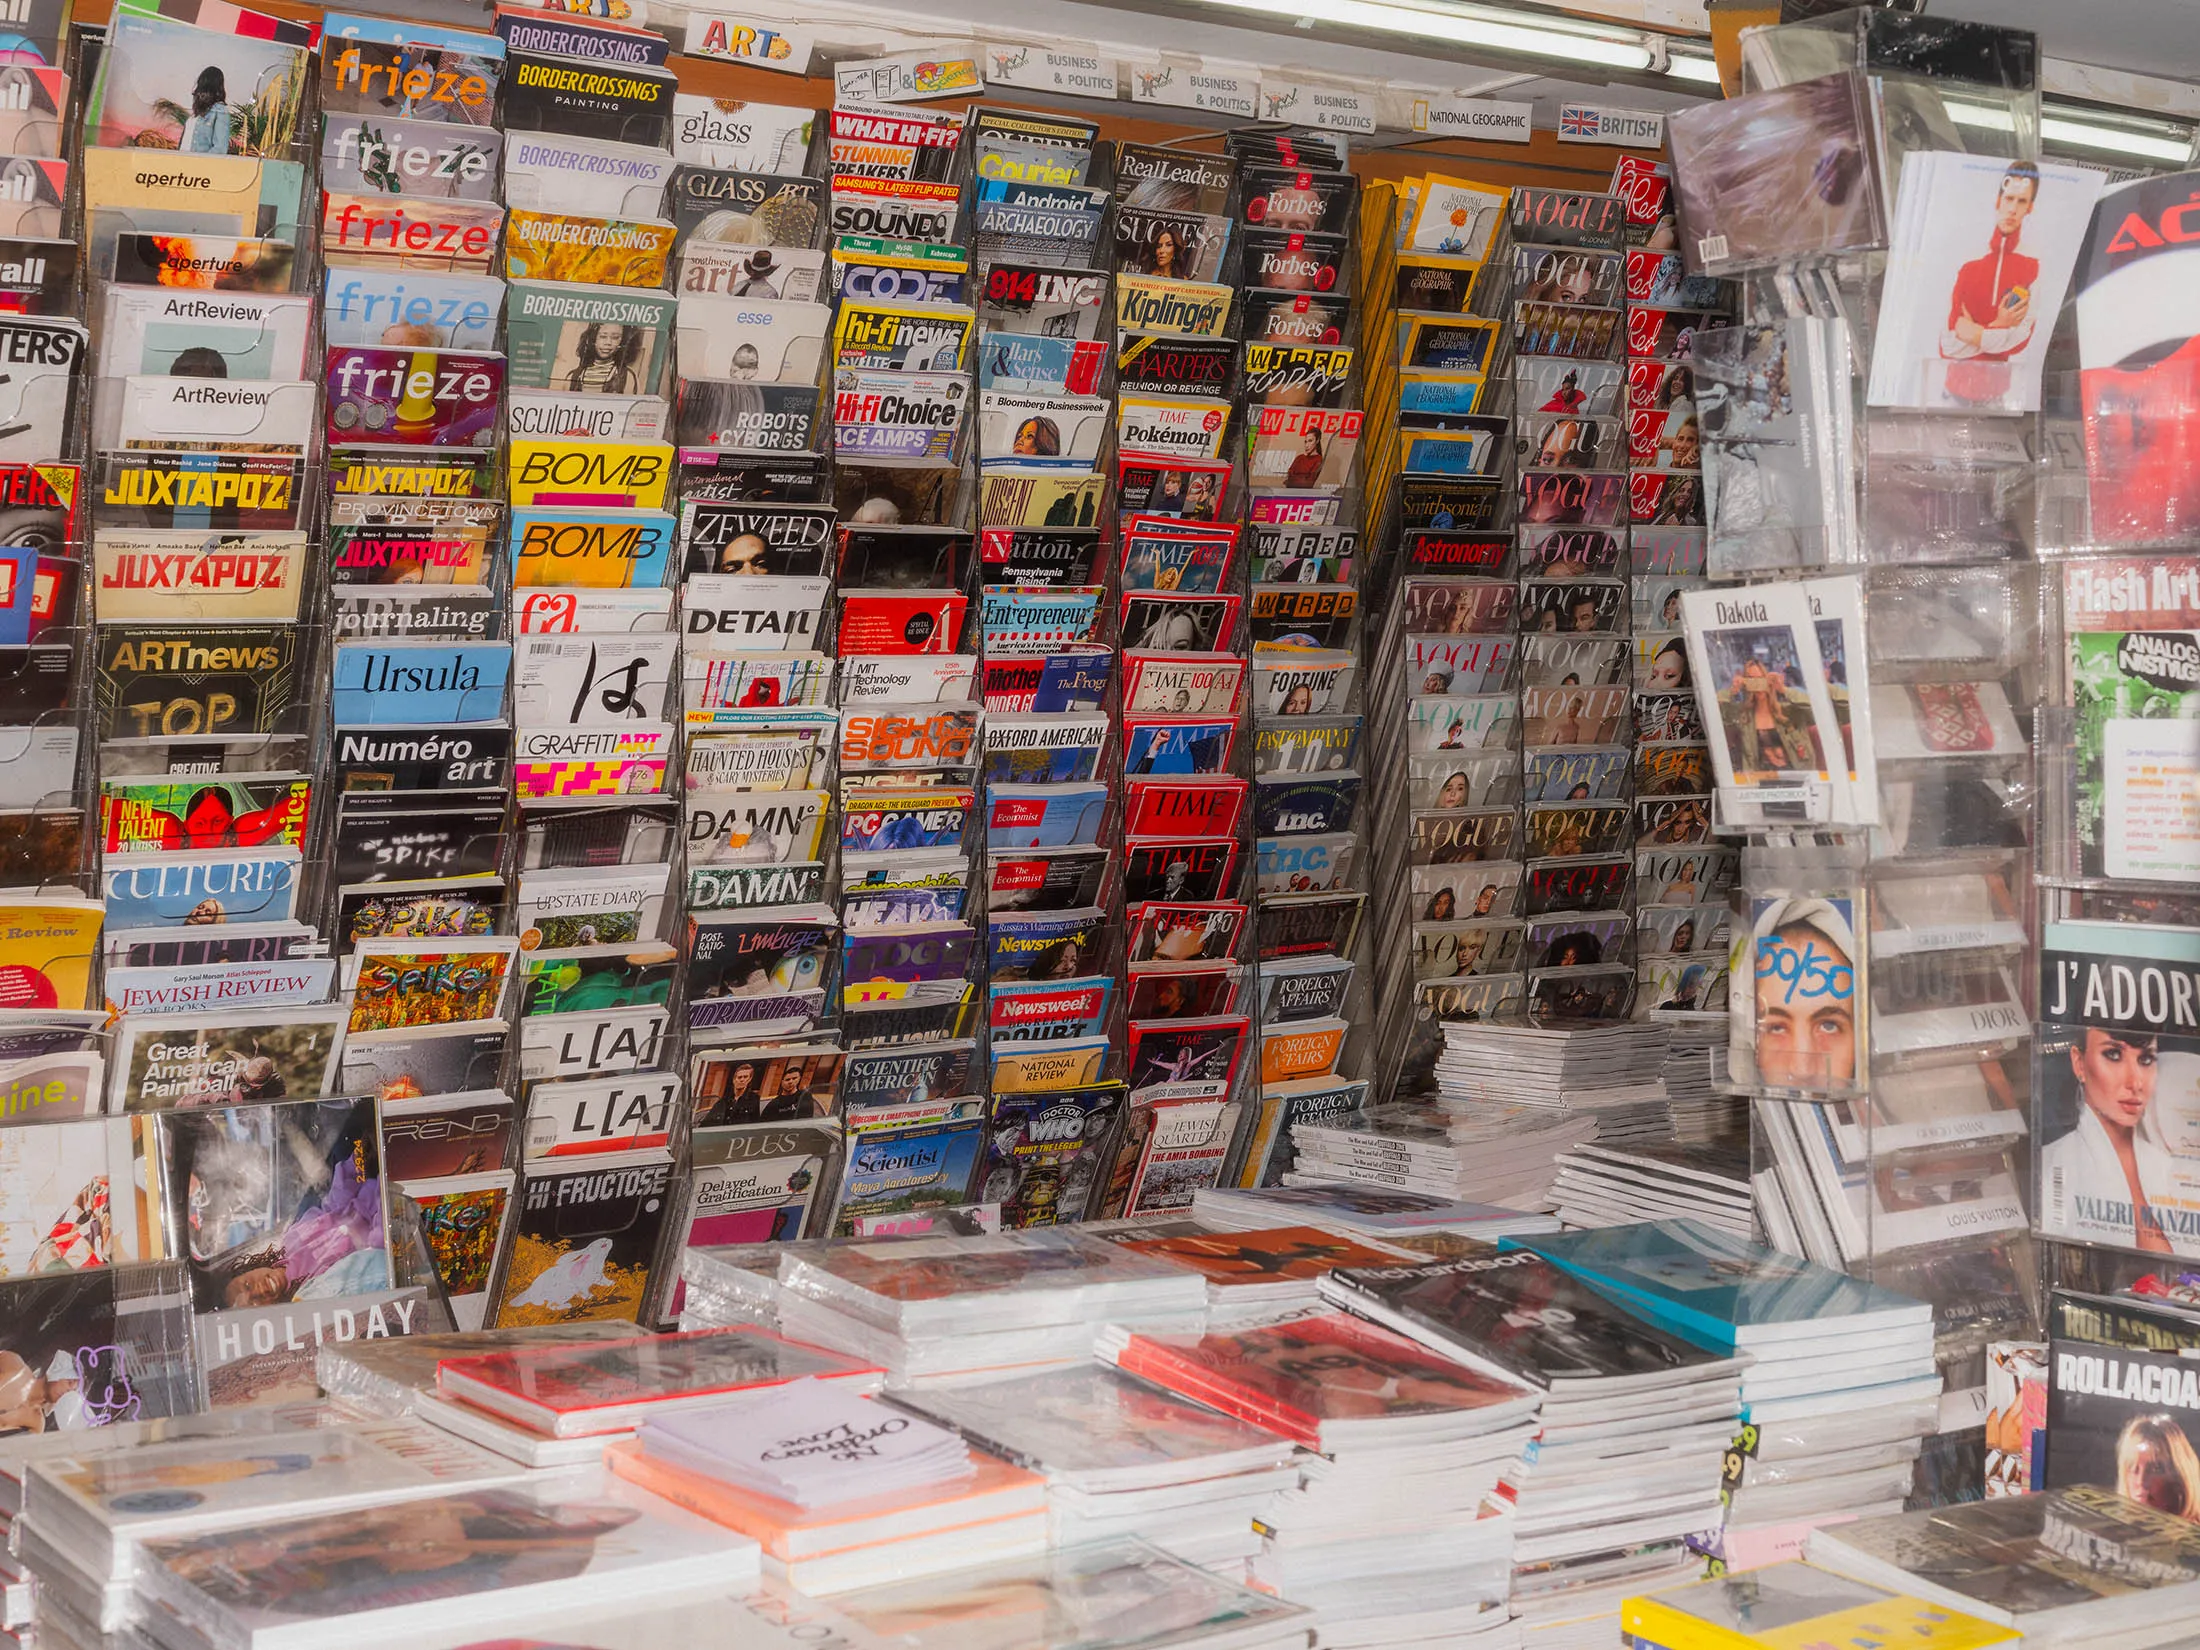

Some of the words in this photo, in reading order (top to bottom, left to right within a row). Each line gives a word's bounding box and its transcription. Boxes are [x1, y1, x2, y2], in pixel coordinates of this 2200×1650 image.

[509, 25, 652, 65] BORDERCROSSINGS
[1047, 54, 1098, 70] BUSINESS
[333, 50, 488, 106] frieze
[518, 64, 662, 102] BORDERCROSSINGS
[1054, 73, 1063, 84] &
[1068, 74, 1113, 90] POLITICS
[1190, 76, 1238, 91] BUSINESS
[555, 96, 619, 112] PAINTING
[1196, 94, 1204, 105] &
[1210, 96, 1251, 111] POLITICS
[1314, 95, 1358, 110] BUSINESS
[681, 111, 752, 145] glass
[1318, 113, 1326, 123] &
[1330, 114, 1371, 128] POLITICS
[1429, 111, 1470, 125] NATIONAL
[1472, 113, 1526, 128] GEOGRAPHIC
[1601, 117, 1658, 137] BRITISH
[333, 128, 488, 182] frieze
[518, 145, 661, 180] BORDERCROSSINGS
[832, 145, 913, 166] STUNNING
[136, 172, 211, 189] aperture
[687, 174, 766, 203] GLASS
[774, 182, 816, 201] ART
[1267, 192, 1328, 216] Forbes
[1627, 178, 1666, 221] Red
[981, 206, 1094, 240] ARCHAEOLOGY
[1524, 191, 1623, 233] VOGUE
[336, 205, 489, 254] frieze
[520, 220, 662, 251] BORDERCROSSINGS
[167, 255, 243, 273] aperture
[1259, 253, 1320, 276] Forbes
[990, 270, 1037, 307] 914
[1034, 275, 1100, 306] INC.
[164, 299, 263, 321] ArtReview
[337, 282, 490, 330] frieze
[523, 295, 664, 324] BORDERCROSSINGS
[737, 310, 773, 325] esse
[1122, 289, 1223, 334] Kiplinger
[846, 313, 900, 345] hi-fi
[895, 324, 962, 348] news
[1264, 314, 1324, 338] Forbes
[1628, 311, 1663, 352] Red
[337, 358, 491, 402] frieze
[173, 387, 269, 405] ArtReview
[997, 397, 1045, 410] Bloomberg
[1046, 401, 1104, 412] Businessweek
[511, 403, 614, 438] sculpture
[738, 412, 809, 431] ROBOTS
[1159, 411, 1191, 424] TIME
[1260, 408, 1364, 438] WIRED
[870, 430, 927, 448] AMPS
[1124, 425, 1211, 445] Pokémon
[1630, 413, 1665, 454] Red
[336, 466, 476, 496] JUXTAPOZ
[518, 452, 663, 487] BOMB
[105, 469, 287, 510] JUXTAPOZ
[1526, 475, 1623, 510] VOGUE
[1403, 495, 1492, 517] Smithsonian
[518, 525, 662, 559] BOMB
[1256, 532, 1357, 558] WIRED
[1412, 536, 1507, 569] Astronomy
[337, 540, 472, 568] JUXTAPOZ
[103, 554, 284, 589] JUXTAPOZ
[1002, 567, 1064, 578] Pennsylvania
[2070, 566, 2149, 614] Flash
[2152, 565, 2200, 612] Art
[983, 600, 1088, 630] Entrepreneur
[1254, 591, 1358, 617] WIRED
[1716, 601, 1768, 625] Dakota
[334, 607, 490, 635] journaling
[687, 610, 810, 634] DETAIL
[109, 641, 279, 671] ARTnews
[1415, 642, 1511, 675] VOGUE
[2126, 634, 2200, 664] ANALOG
[363, 654, 480, 693] Ursula
[857, 664, 878, 673] MIT
[853, 685, 890, 696] Review
[855, 674, 911, 687] Technology
[1269, 670, 1338, 693] FORTUNE
[1531, 687, 1625, 720] VOGUE
[688, 713, 713, 721] NEW!
[845, 716, 954, 738] SIGHT
[341, 736, 472, 762] Numéro
[528, 734, 617, 756] GRAFFITI
[616, 734, 662, 753] ART
[988, 729, 1038, 748] OXFORD
[1039, 727, 1103, 747] AMERICAN
[691, 750, 754, 772] HAUNTED
[757, 748, 809, 769] HOUSES
[841, 738, 973, 761] SOUND
[447, 756, 496, 781] art
[707, 772, 714, 785] &
[742, 770, 786, 783] MYSTERIES
[1533, 756, 1625, 785] VOGUE
[121, 800, 153, 820] NEW
[849, 801, 873, 809] DRAGON
[1153, 790, 1226, 817] TIME
[118, 817, 167, 840] TALENT
[846, 813, 879, 835] PC
[996, 813, 1038, 823] Economist
[1275, 812, 1327, 832] Inc.
[1417, 815, 1513, 849] VOGUE
[1257, 842, 1329, 874] Inc.
[105, 860, 296, 899] CULTURED
[997, 873, 1042, 885] Economist
[535, 894, 600, 911] UPSTATE
[603, 890, 647, 907] DIARY
[6, 927, 78, 939] Review
[701, 933, 724, 942] POST-
[696, 951, 713, 960] NAL
[699, 941, 725, 950] RATIO-
[174, 975, 188, 984] Gary
[204, 972, 225, 980] Morson
[241, 969, 272, 978] Schlepped
[1755, 936, 1854, 1004] 50/50
[118, 984, 211, 1012] JEWISH
[217, 976, 312, 998] REVIEW
[1280, 974, 1341, 995] FOREIGN
[2050, 959, 2200, 1027] J'ADOR
[1001, 994, 1091, 1017] Newsweek
[1280, 990, 1331, 1008] AFFAIRS
[1970, 1008, 2020, 1032] DIOR
[147, 1042, 210, 1061] Great
[1175, 1035, 1203, 1046] TIME
[1272, 1035, 1333, 1054] FOREIGN
[144, 1060, 248, 1081] American
[851, 1056, 943, 1077] SCIENTIFIC
[1020, 1059, 1075, 1072] NATIONAL
[1272, 1051, 1324, 1068] AFFAIRS
[140, 1074, 236, 1099] Paintball
[849, 1071, 937, 1093] AMERICAN
[1026, 1070, 1067, 1081] REVIEW
[1041, 1106, 1081, 1121] DOCTOR
[1029, 1117, 1085, 1142] WHO
[726, 1133, 800, 1161] PLUS
[1151, 1153, 1165, 1162] THE
[1166, 1151, 1186, 1161] AMIA
[1189, 1148, 1225, 1159] BOMBING
[854, 1150, 938, 1174] Scientist
[697, 1183, 782, 1205] Gratification
[700, 1176, 757, 1194] Delayed
[851, 1180, 880, 1193] Maya
[883, 1172, 949, 1190] Agroforestry
[1947, 1211, 1978, 1227] LOUIS
[1979, 1206, 2019, 1223] VUITTON
[216, 1299, 418, 1361] HOLIDAY
[2057, 1353, 2200, 1409] ROLLACOA
[761, 1418, 909, 1461] Ordinary
[779, 1423, 853, 1448] Love
[831, 1446, 880, 1461] No
